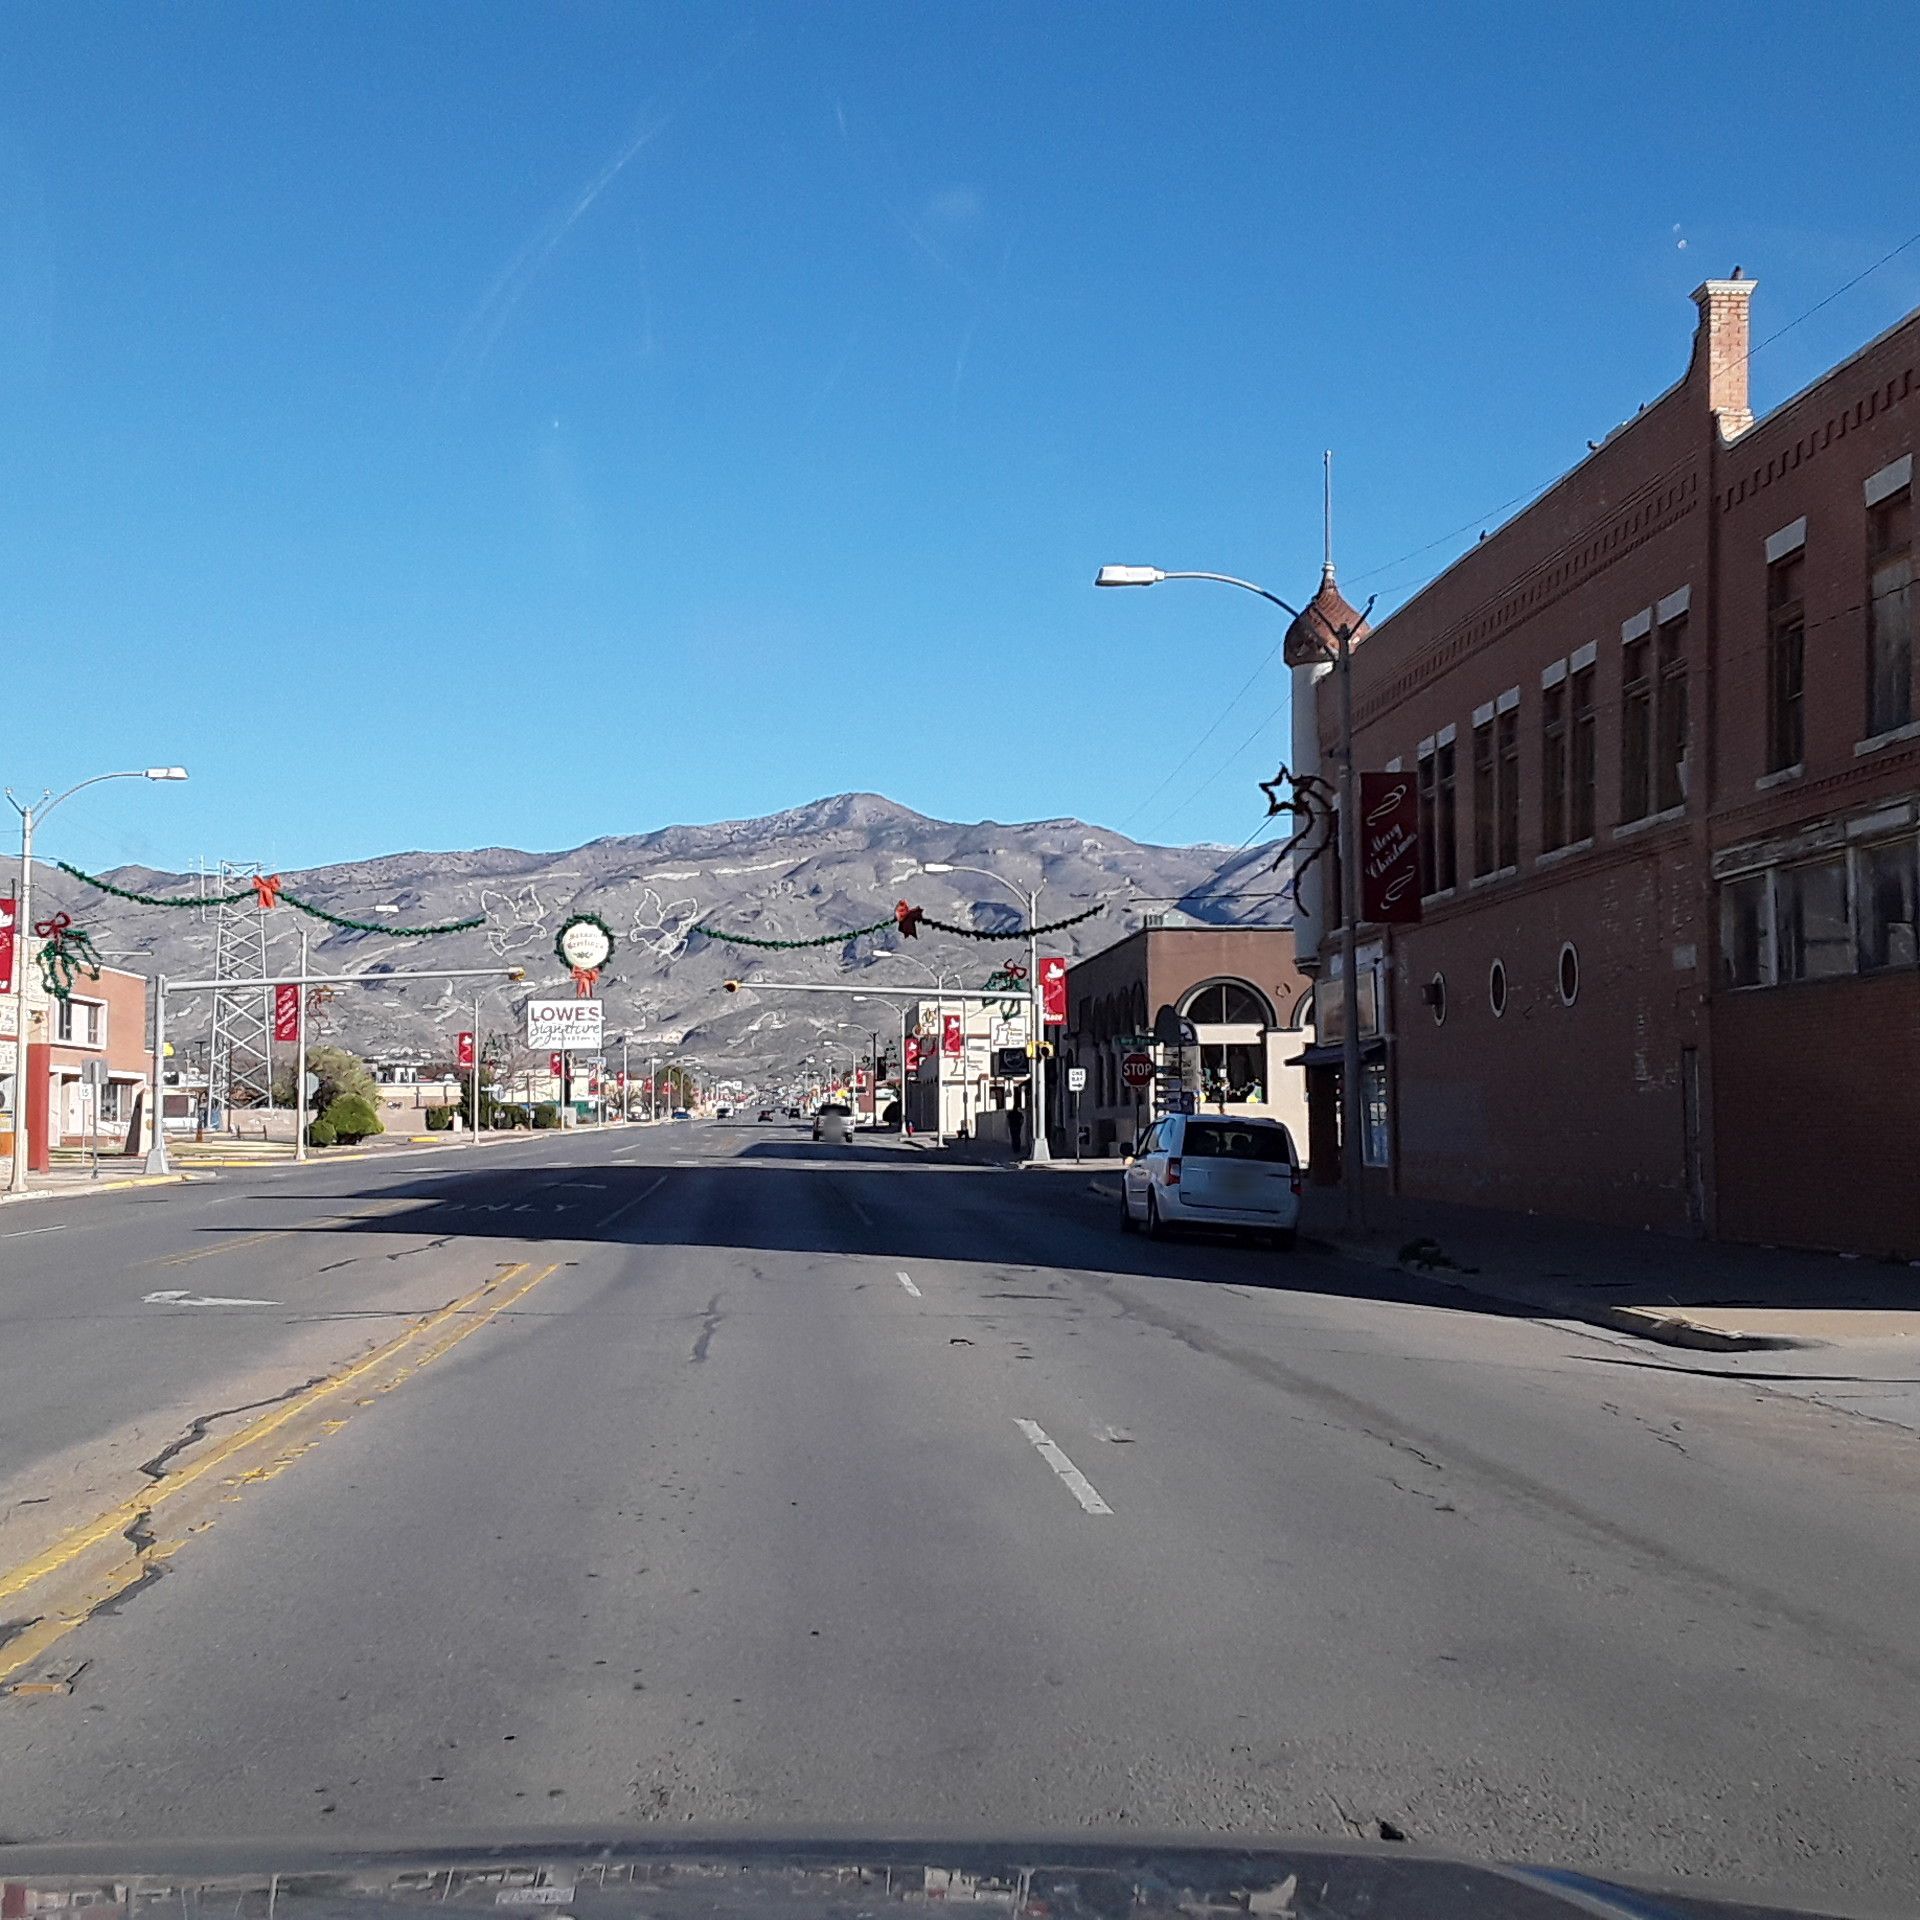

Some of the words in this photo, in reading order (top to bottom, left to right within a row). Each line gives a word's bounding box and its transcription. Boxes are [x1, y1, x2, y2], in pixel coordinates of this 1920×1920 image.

[1371, 823, 1403, 852] Merry
[530, 1006, 600, 1022] LOWES
[530, 1020, 600, 1045] Signature
[1123, 1063, 1152, 1076] STOP
